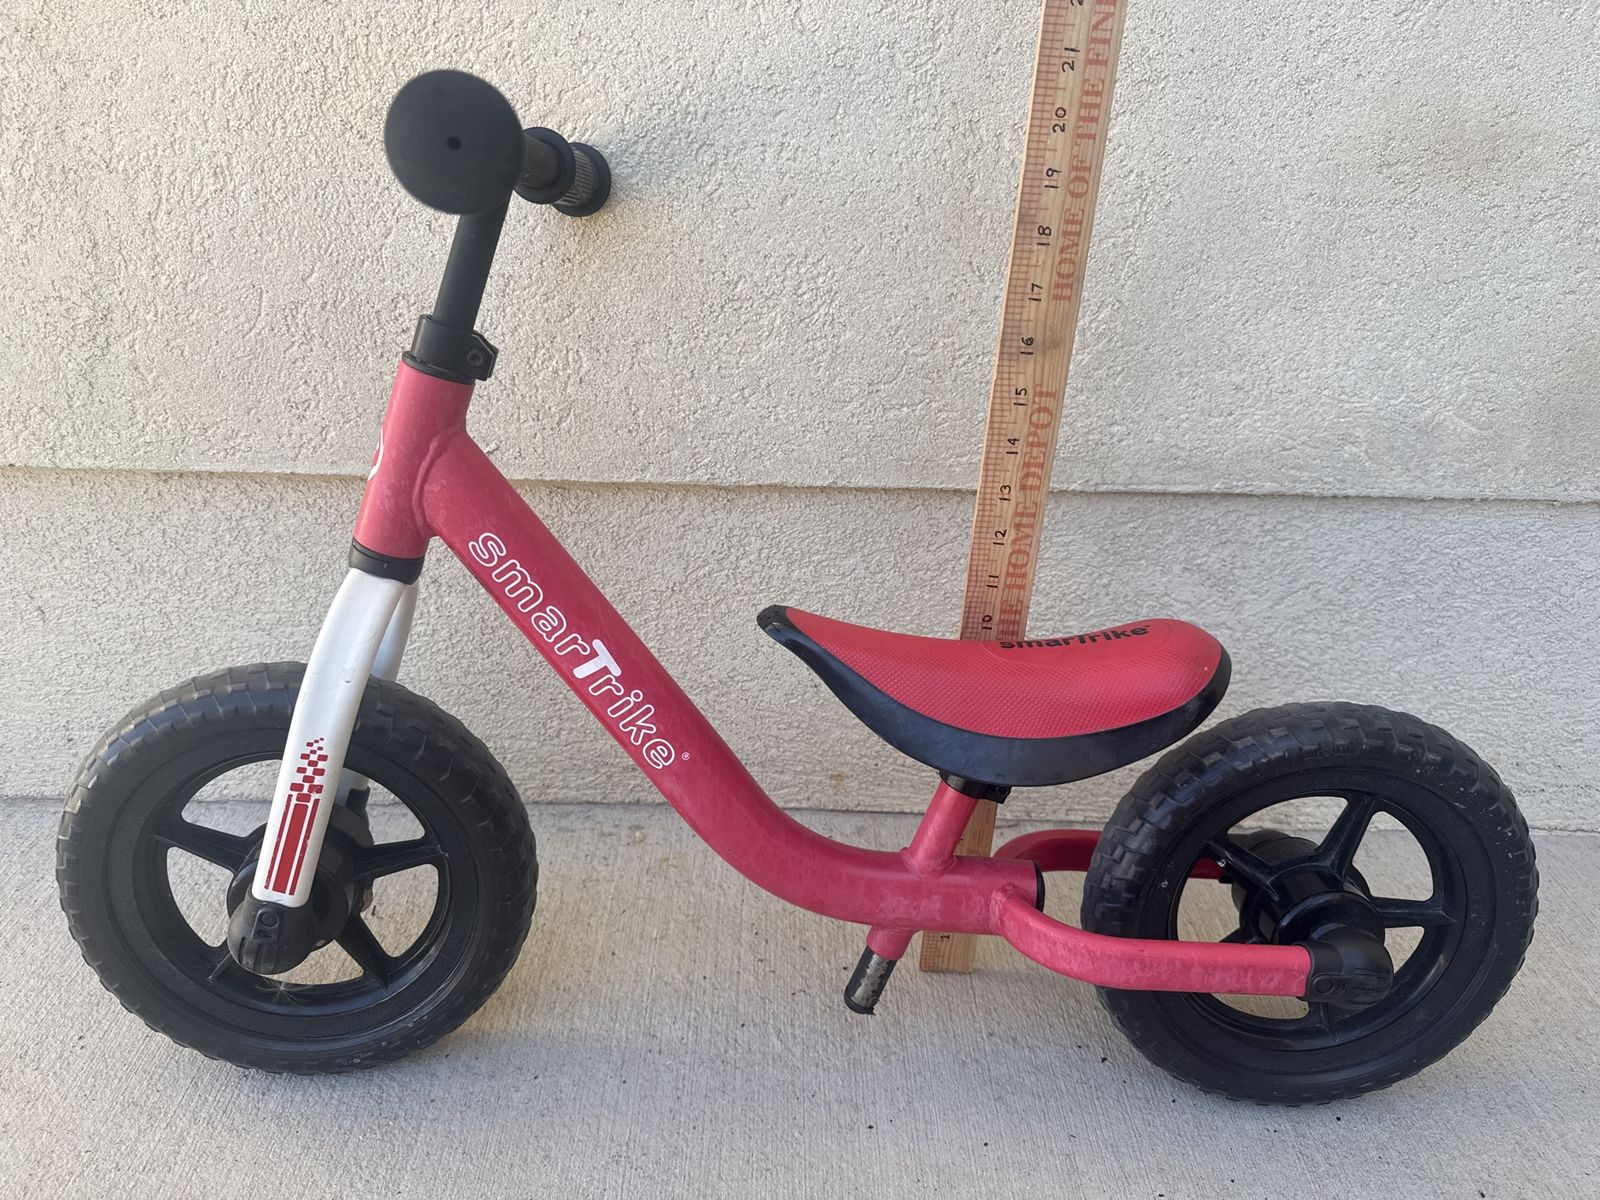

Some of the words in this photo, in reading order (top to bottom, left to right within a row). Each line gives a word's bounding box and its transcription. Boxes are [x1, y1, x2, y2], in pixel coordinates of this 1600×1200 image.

[1085, 0, 1118, 68] FIN
[1061, 47, 1081, 73] 21
[1052, 106, 1067, 134] 20
[1075, 79, 1105, 146] THE
[1044, 167, 1063, 189] 19
[1068, 155, 1093, 199] OF
[1036, 225, 1052, 246] 18
[1052, 208, 1085, 303] HOME
[1028, 282, 1043, 302] 17
[1020, 336, 1034, 355] 16
[1013, 387, 1028, 406] 15
[1005, 437, 1020, 455] 14
[1019, 383, 1057, 492] DEPOT
[998, 484, 1012, 501] 13
[993, 528, 1008, 546] 12
[1002, 502, 1038, 593] HOME
[985, 574, 999, 588] 11
[981, 614, 993, 631] 10
